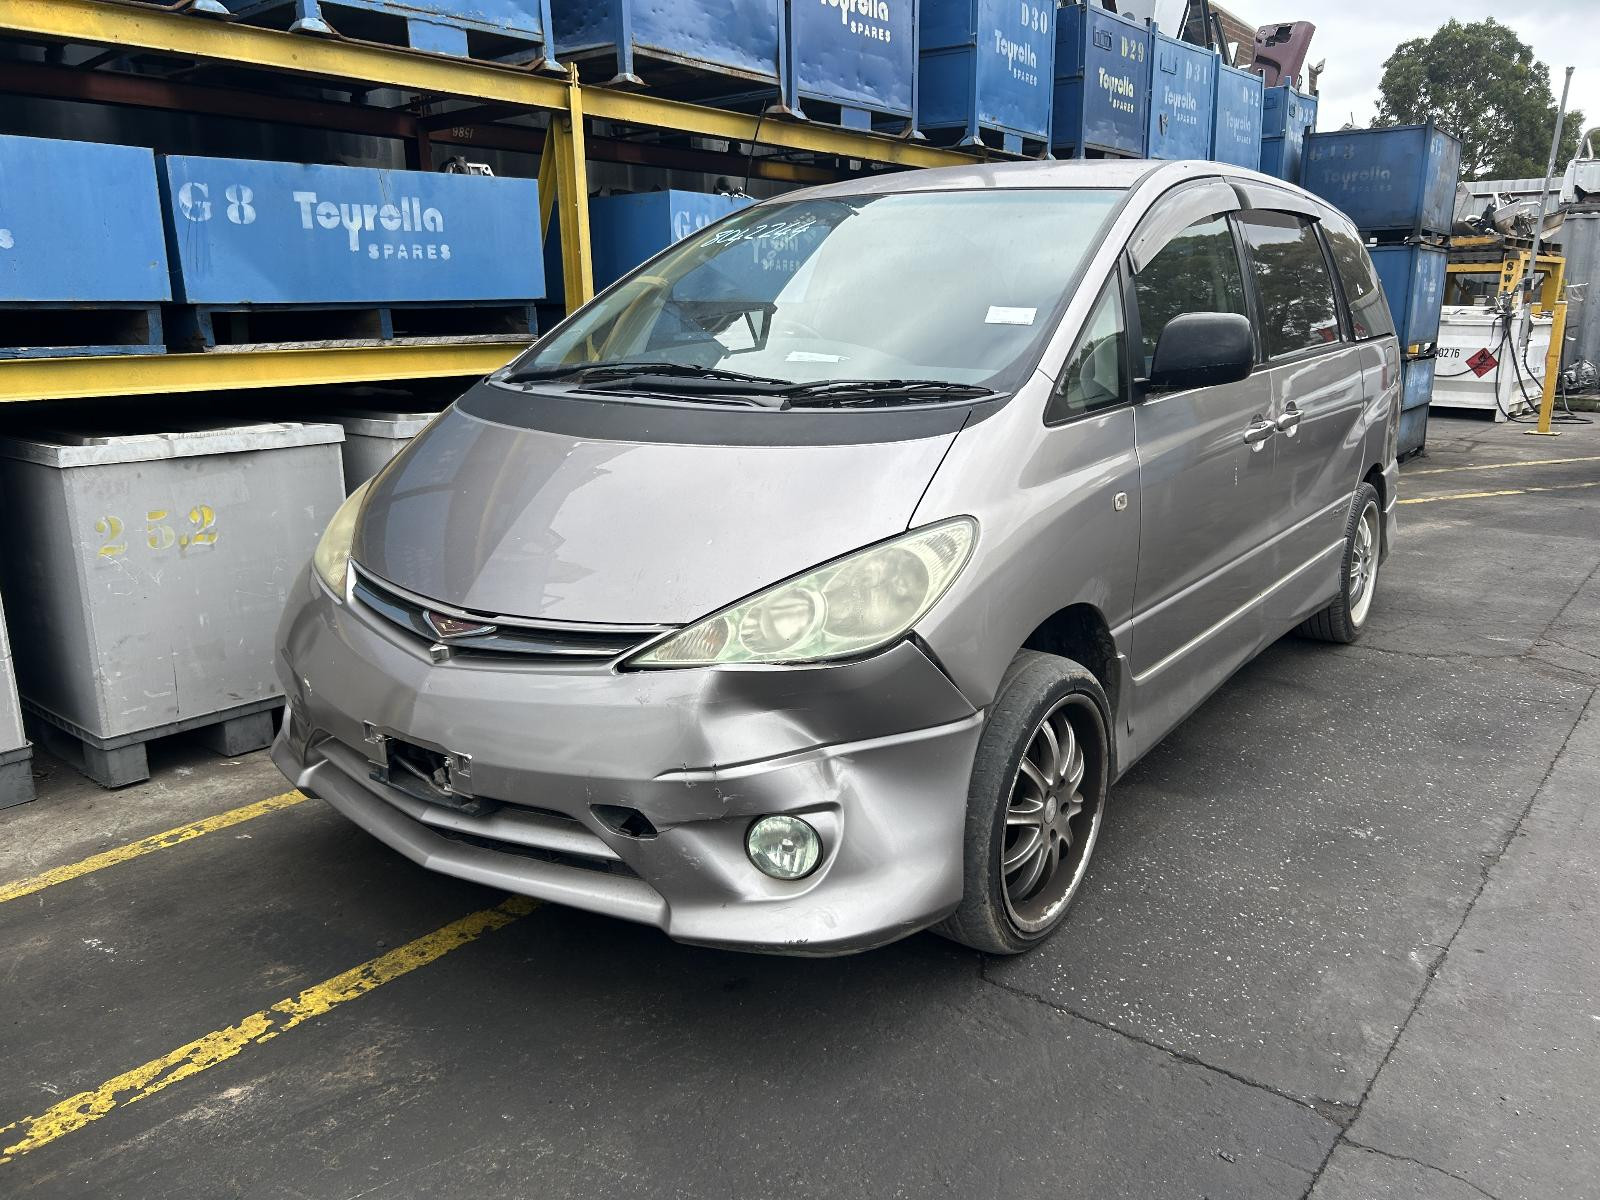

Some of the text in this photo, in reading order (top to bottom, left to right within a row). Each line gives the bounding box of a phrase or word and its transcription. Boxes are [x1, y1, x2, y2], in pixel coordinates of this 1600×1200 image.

[850, 20, 891, 42] SPARES
[1021, 2, 1048, 35] D30
[994, 28, 1037, 72] Toyrolla
[1121, 36, 1145, 62] D29
[1013, 67, 1037, 87] SPARES
[1098, 67, 1134, 102] Toyrolla
[1185, 60, 1207, 85] D31
[1112, 99, 1134, 113] SPARES
[1164, 85, 1197, 117] Toyrolla
[292, 190, 444, 252] Toyrolla
[368, 243, 451, 260] SPARES
